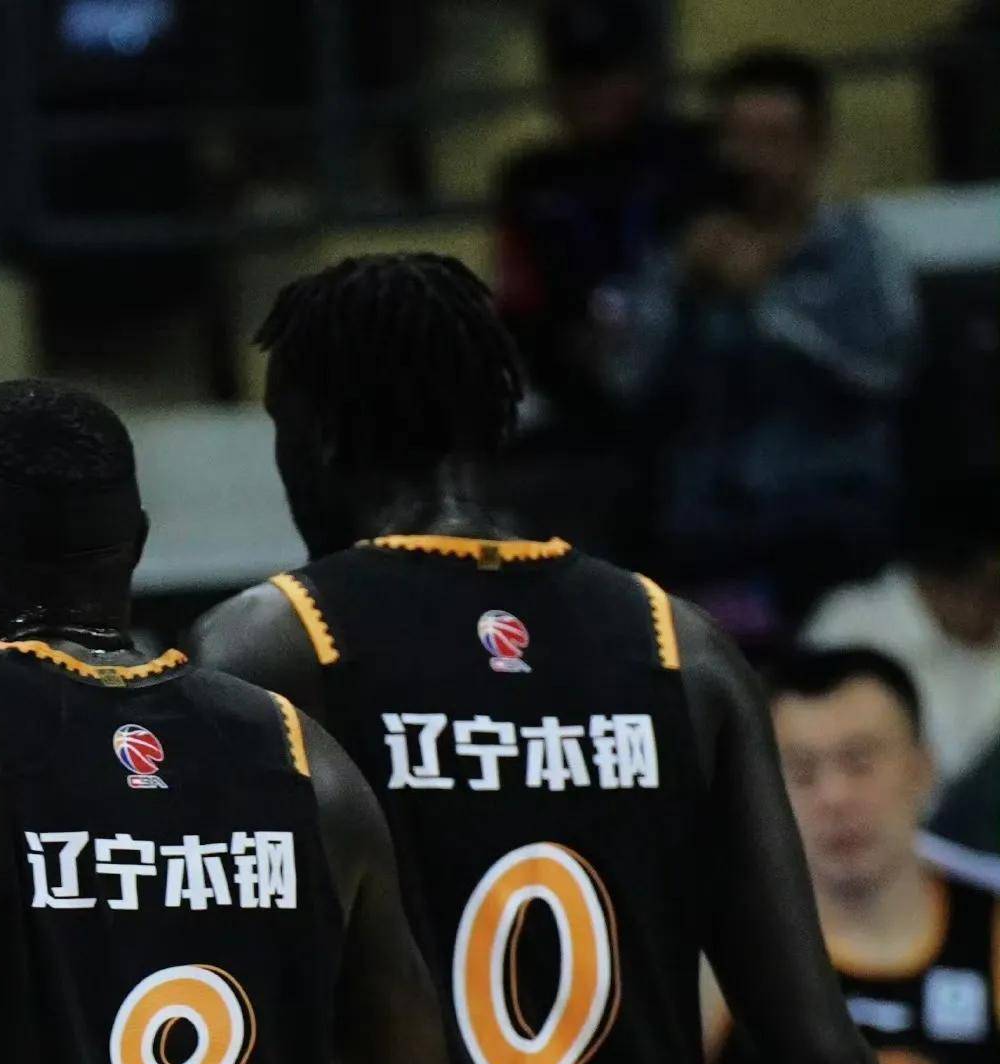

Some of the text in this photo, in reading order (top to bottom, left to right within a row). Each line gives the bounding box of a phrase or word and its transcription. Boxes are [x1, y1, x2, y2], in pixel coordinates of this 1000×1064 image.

[381, 713, 659, 791] 辽宁本钢
[24, 831, 297, 910] 辽宁本钢
